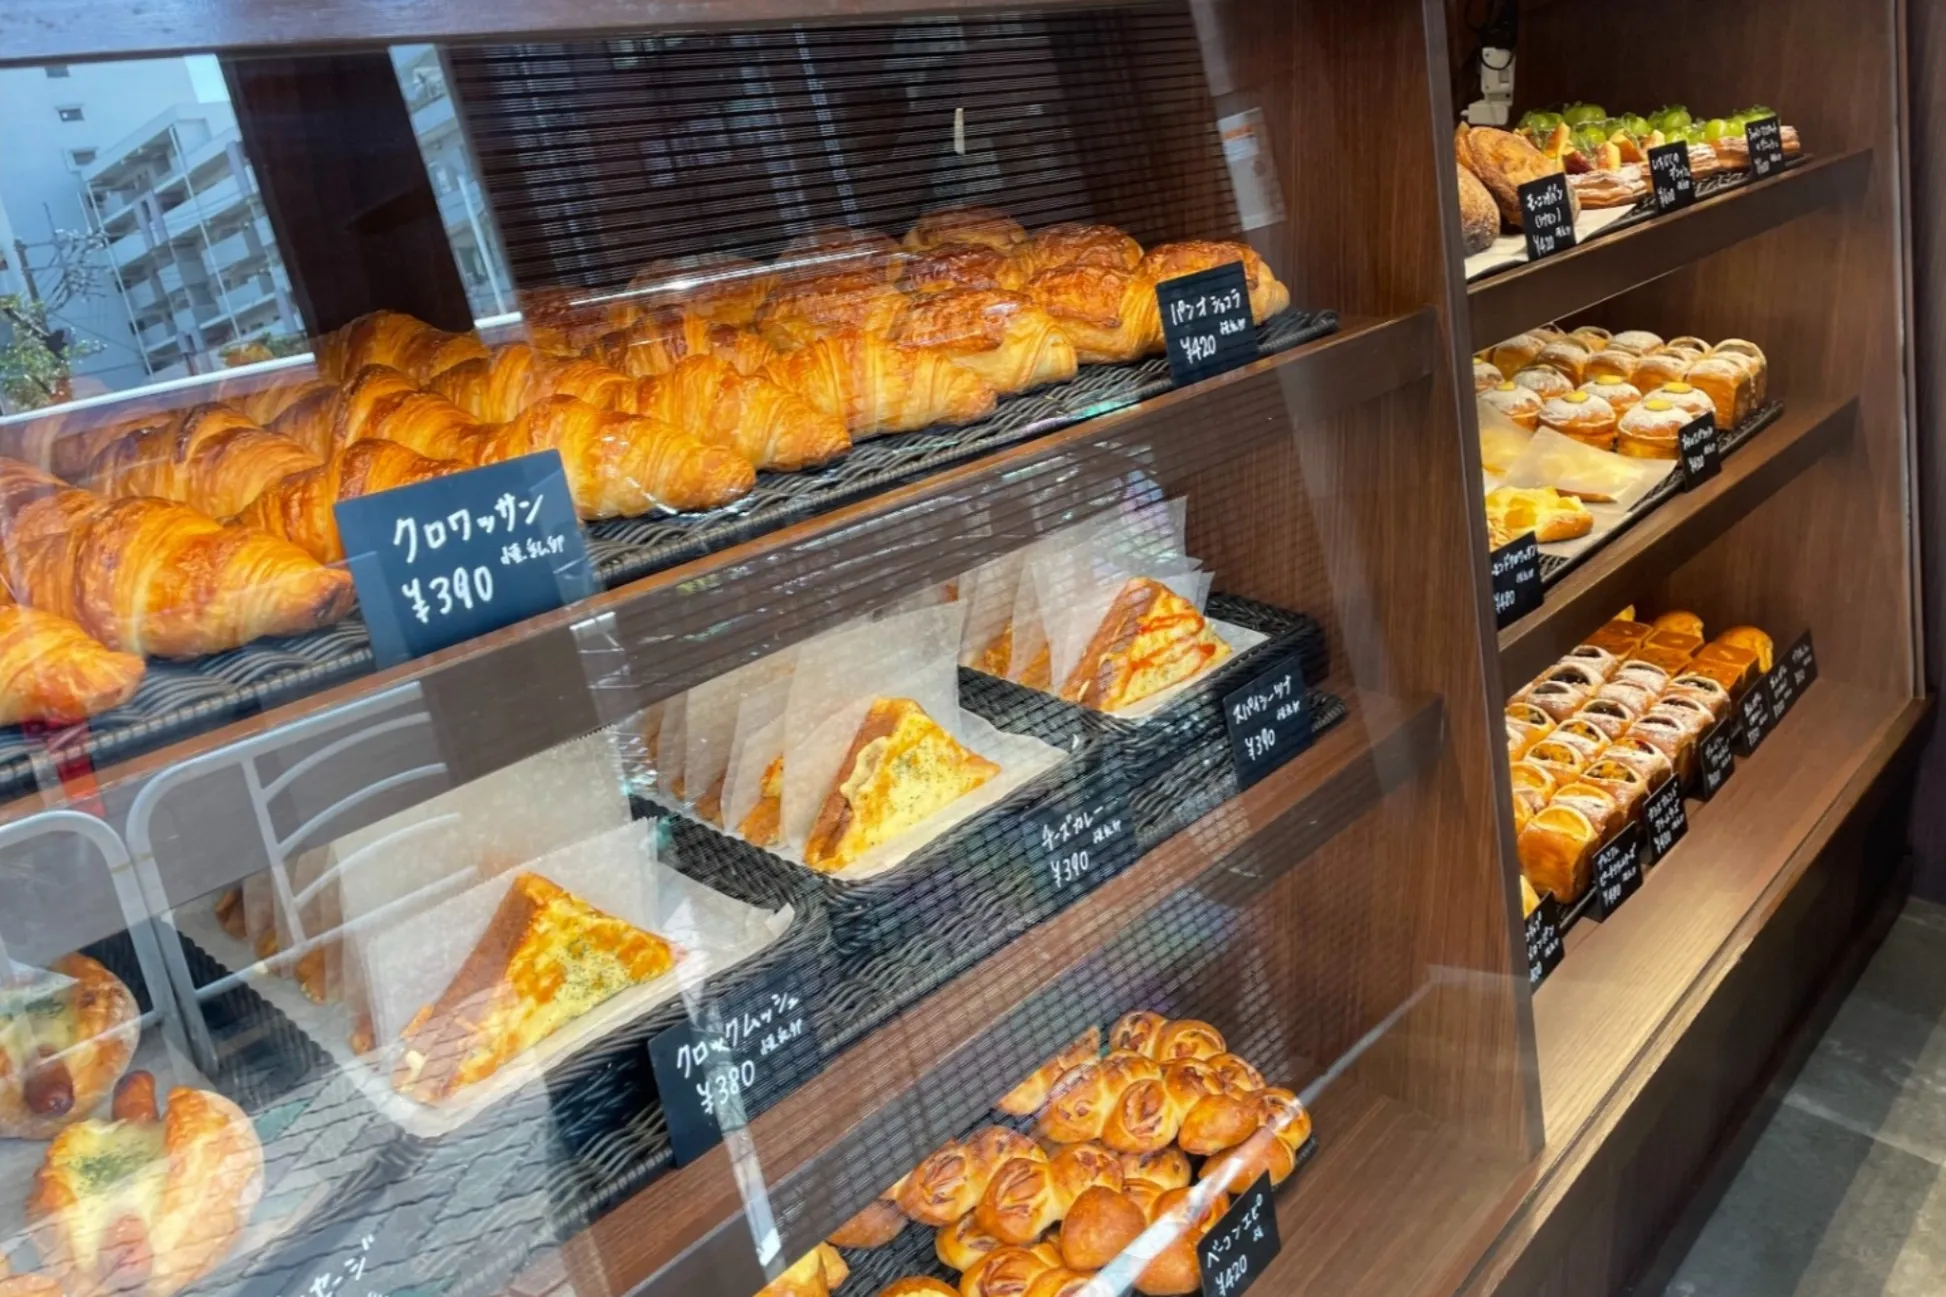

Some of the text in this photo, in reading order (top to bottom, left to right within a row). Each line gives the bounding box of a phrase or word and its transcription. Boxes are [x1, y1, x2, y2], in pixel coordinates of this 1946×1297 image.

[1179, 334, 1217, 365] ¥420
[392, 492, 545, 564] クロワッサン
[401, 564, 494, 624] ¥390
[1244, 727, 1276, 761] ¥390
[1041, 806, 1104, 851] チーズカレー
[1050, 850, 1089, 889] ¥390
[676, 992, 800, 1079] クロックムッシュ
[696, 1060, 756, 1115] ¥380
[1214, 1254, 1248, 1297] ¥420
